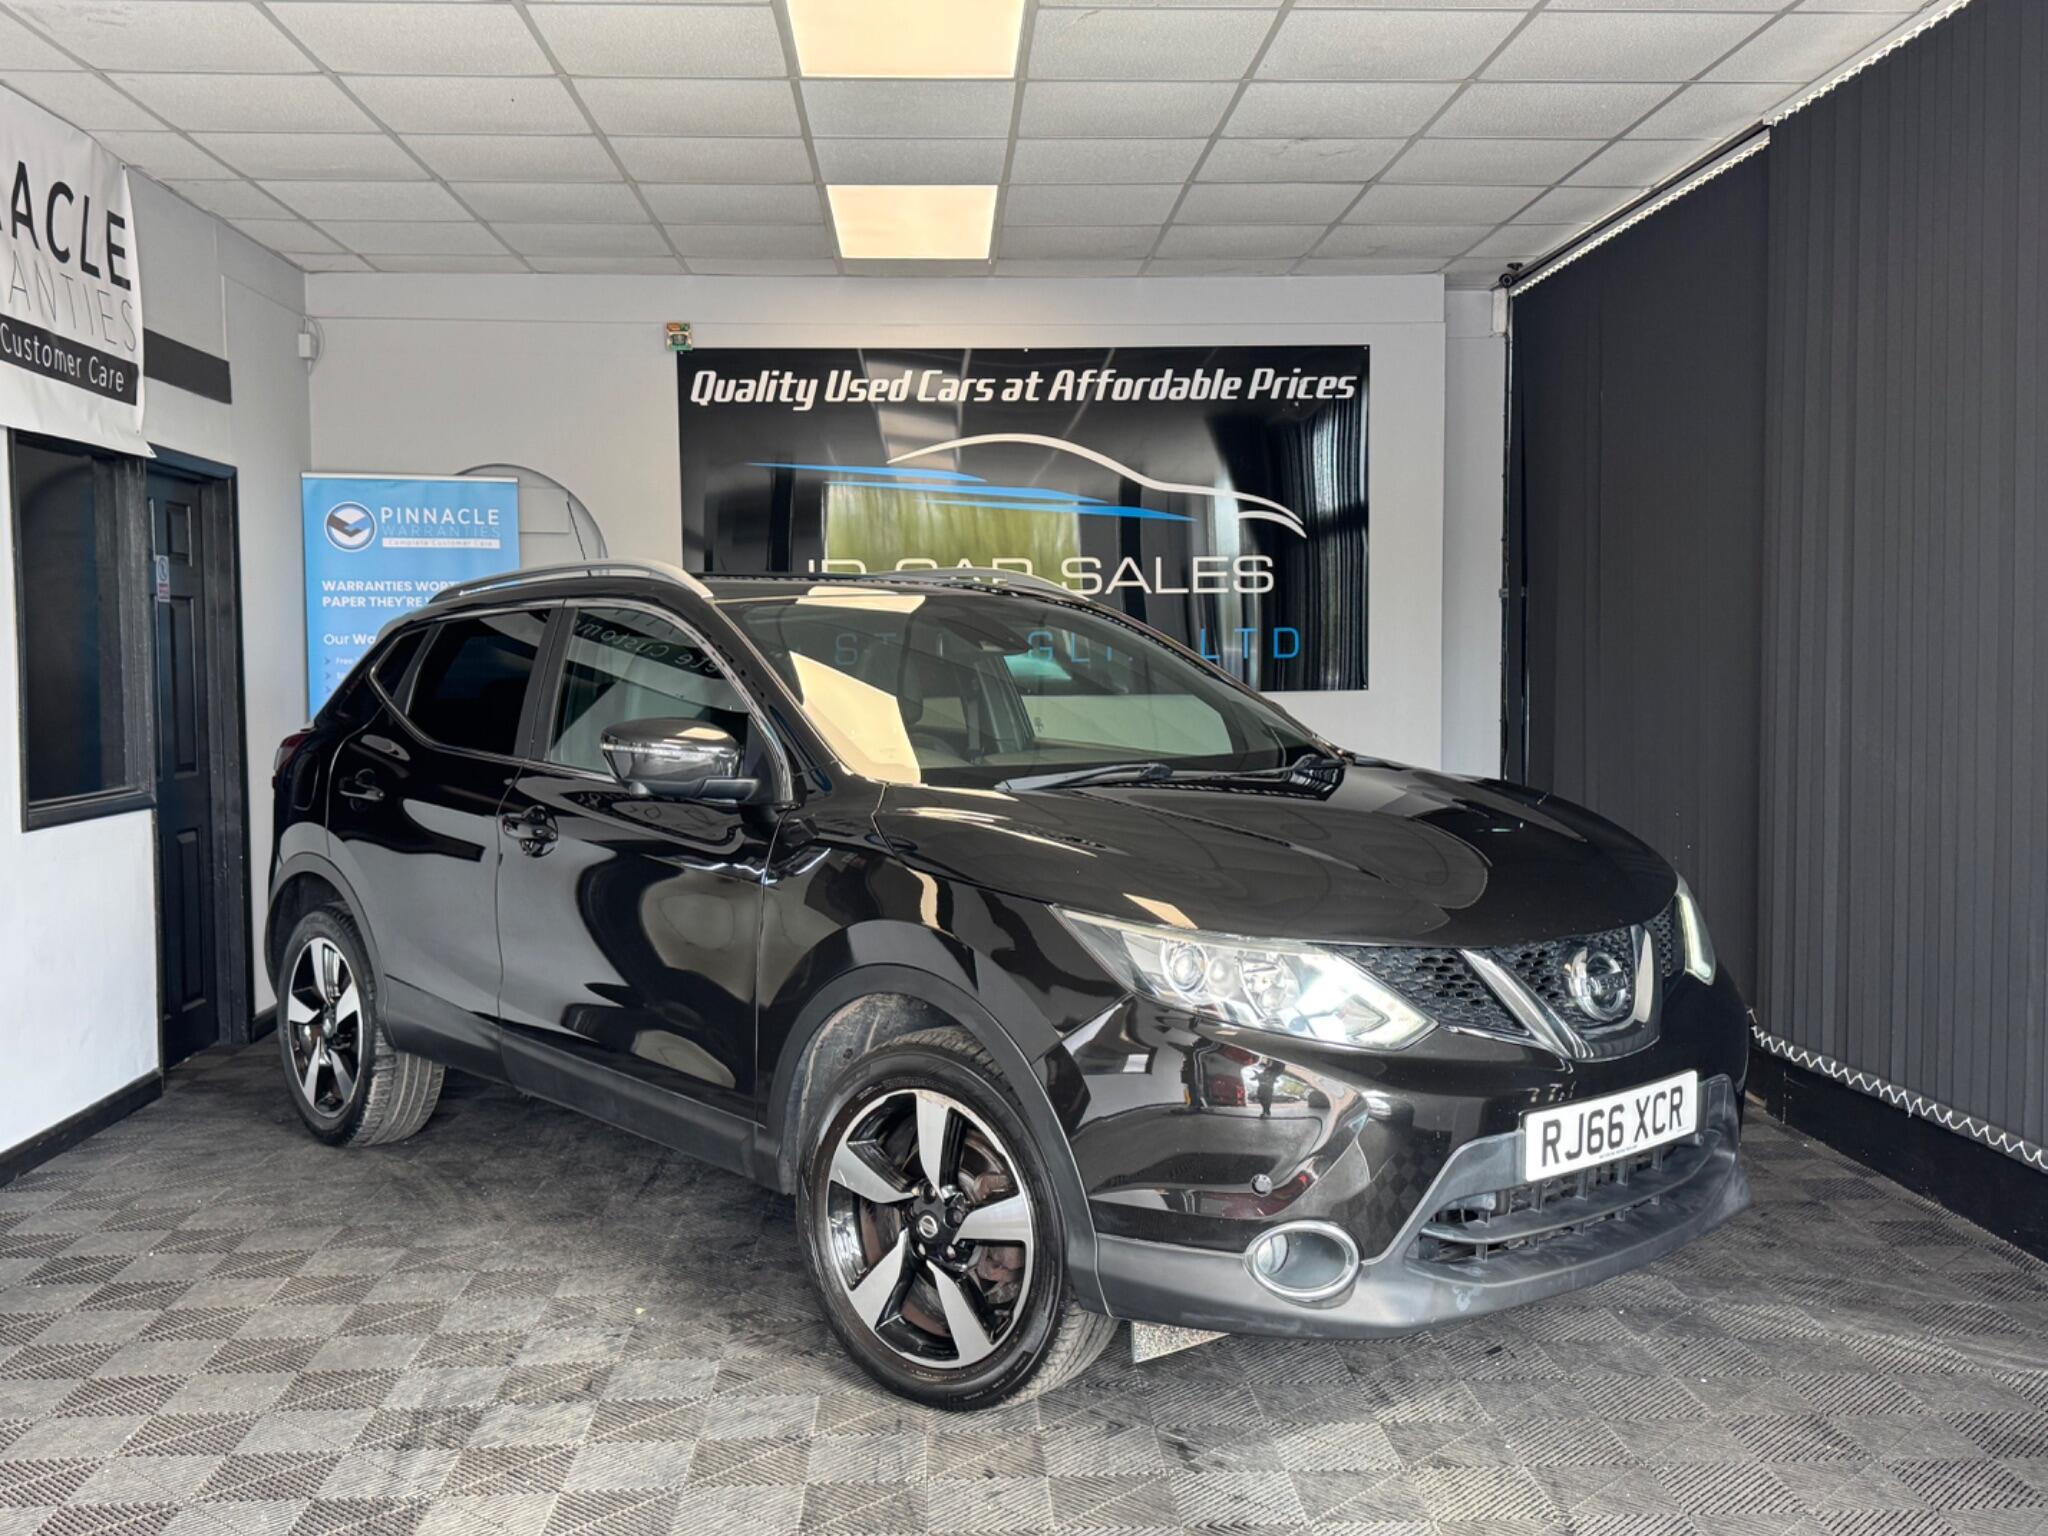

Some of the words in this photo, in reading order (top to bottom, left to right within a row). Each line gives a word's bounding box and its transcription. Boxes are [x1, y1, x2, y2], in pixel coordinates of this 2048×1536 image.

[0, 160, 131, 291] ACLE
[0, 322, 83, 379] Customer
[88, 355, 125, 393] Care
[689, 369, 819, 412] Quality
[824, 369, 914, 403] Used
[917, 369, 997, 403] Cars
[1001, 370, 1044, 402] at
[1048, 368, 1243, 402] Affordable
[1247, 367, 1358, 400] Prices
[380, 506, 500, 526] PINNACLE
[381, 525, 501, 538] WARRANTIES
[321, 580, 413, 592] WARRANTIES
[415, 580, 457, 592] WOR
[1060, 554, 1275, 596] SALES
[322, 597, 366, 609] PAPER
[369, 596, 423, 609] THEY'RE
[323, 633, 350, 646] Our
[1200, 625, 1300, 663] LTD
[1541, 1103, 1625, 1168] RJ66
[1633, 1085, 1685, 1144] XCR
